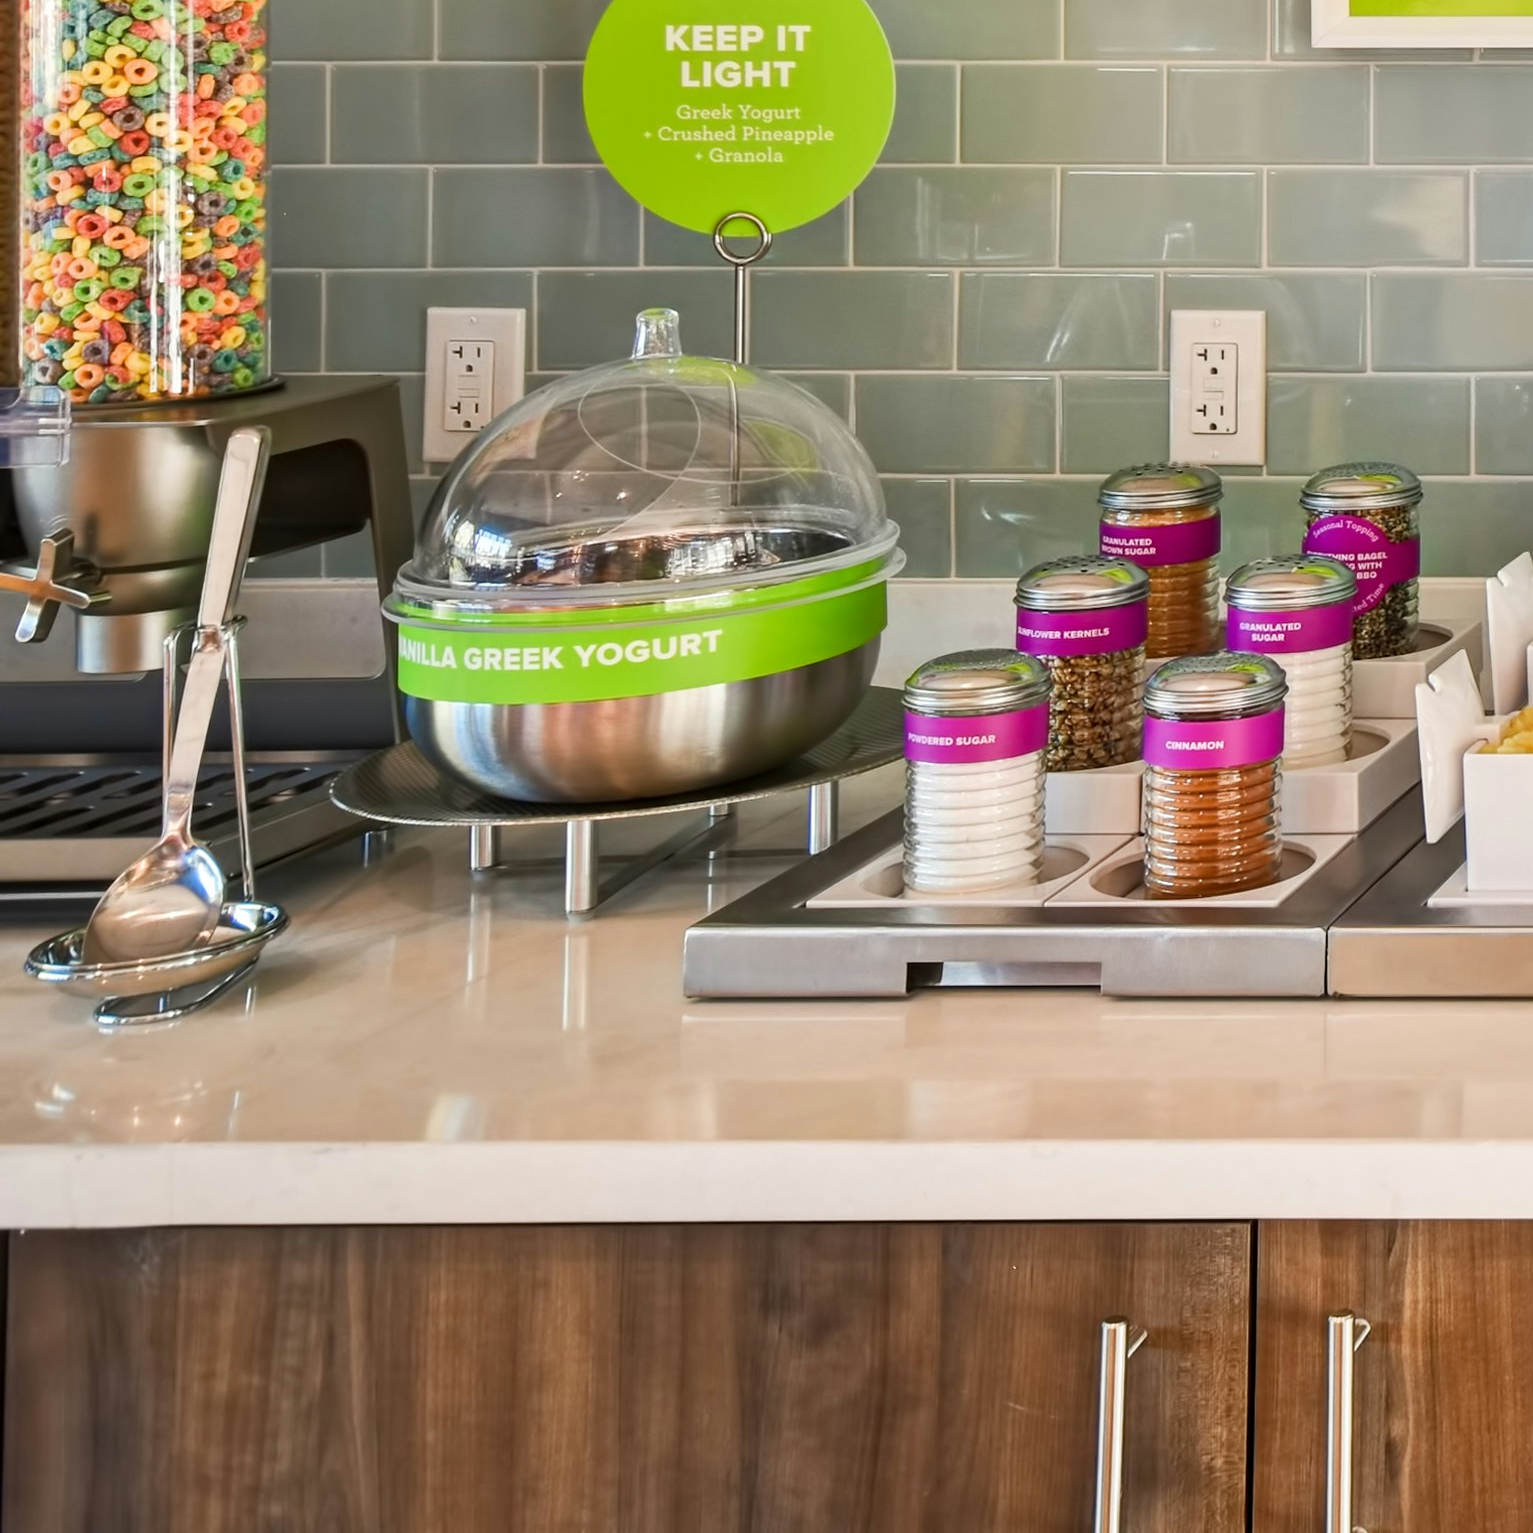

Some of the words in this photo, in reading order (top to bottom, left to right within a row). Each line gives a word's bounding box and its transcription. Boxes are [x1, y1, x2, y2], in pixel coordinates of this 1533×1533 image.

[665, 25, 764, 52] KEEP
[777, 25, 811, 52] IT
[681, 61, 796, 88] LIGHT
[676, 103, 733, 120] Greek
[738, 104, 801, 123] Yogurt
[658, 125, 737, 141] Crushed
[742, 125, 835, 144] Pineapple
[709, 147, 784, 163] Granola
[1312, 520, 1344, 538] Seasonal
[1345, 520, 1379, 542] Topping
[1124, 547, 1156, 556] SUGAR
[1357, 552, 1388, 561] BAGEL
[1358, 561, 1383, 570] WITH
[1366, 583, 1385, 603] Time
[1063, 627, 1110, 639] KERNELS
[1239, 622, 1301, 632] GRANULATED
[1251, 634, 1285, 642] SUGAR
[464, 646, 564, 671] GREEK
[573, 629, 723, 668] YOGURT
[908, 732, 953, 746] POWDERED
[956, 734, 996, 746] SUGAR
[1165, 741, 1224, 750] CINNAMON
